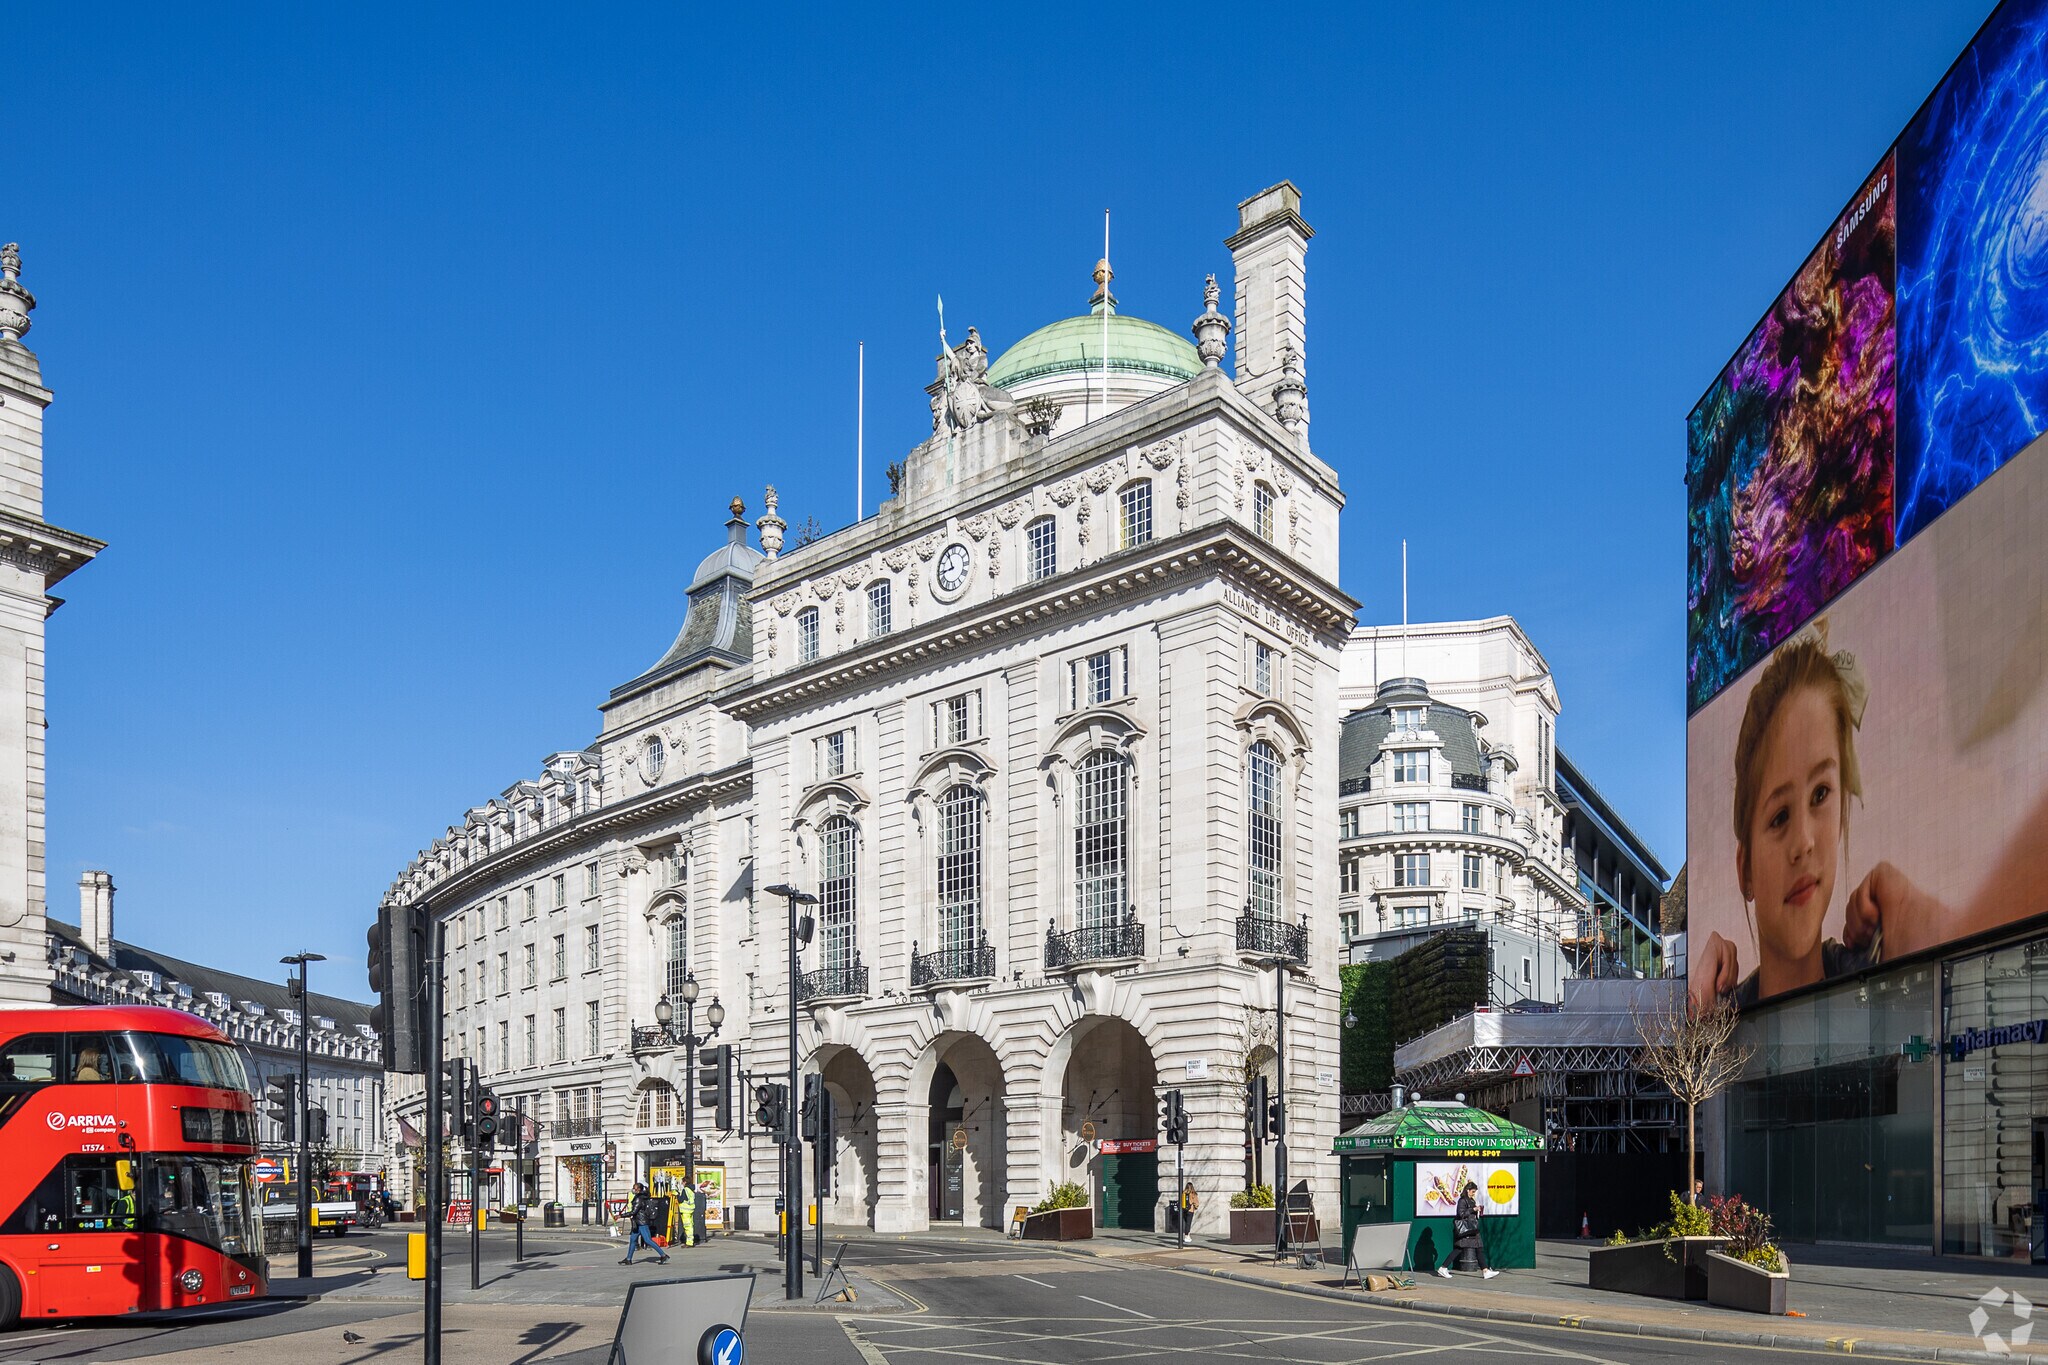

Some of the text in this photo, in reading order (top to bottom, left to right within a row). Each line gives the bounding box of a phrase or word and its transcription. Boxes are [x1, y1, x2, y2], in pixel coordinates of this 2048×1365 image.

[1837, 174, 1888, 250] SAMSUNG
[1223, 588, 1309, 647] ALLIANCE LIFE OFFICE
[1955, 1020, 2045, 1057] pharmacy
[67, 1115, 117, 1127] ARRIVA
[1422, 1118, 1501, 1133] WICKED
[82, 1144, 105, 1152] LT574
[570, 1143, 592, 1152] NESPRESSO
[648, 1137, 677, 1147] NESPRESSO
[1434, 1138, 1455, 1147] BEST
[1458, 1138, 1485, 1147] SHOW
[1487, 1138, 1498, 1147] IN
